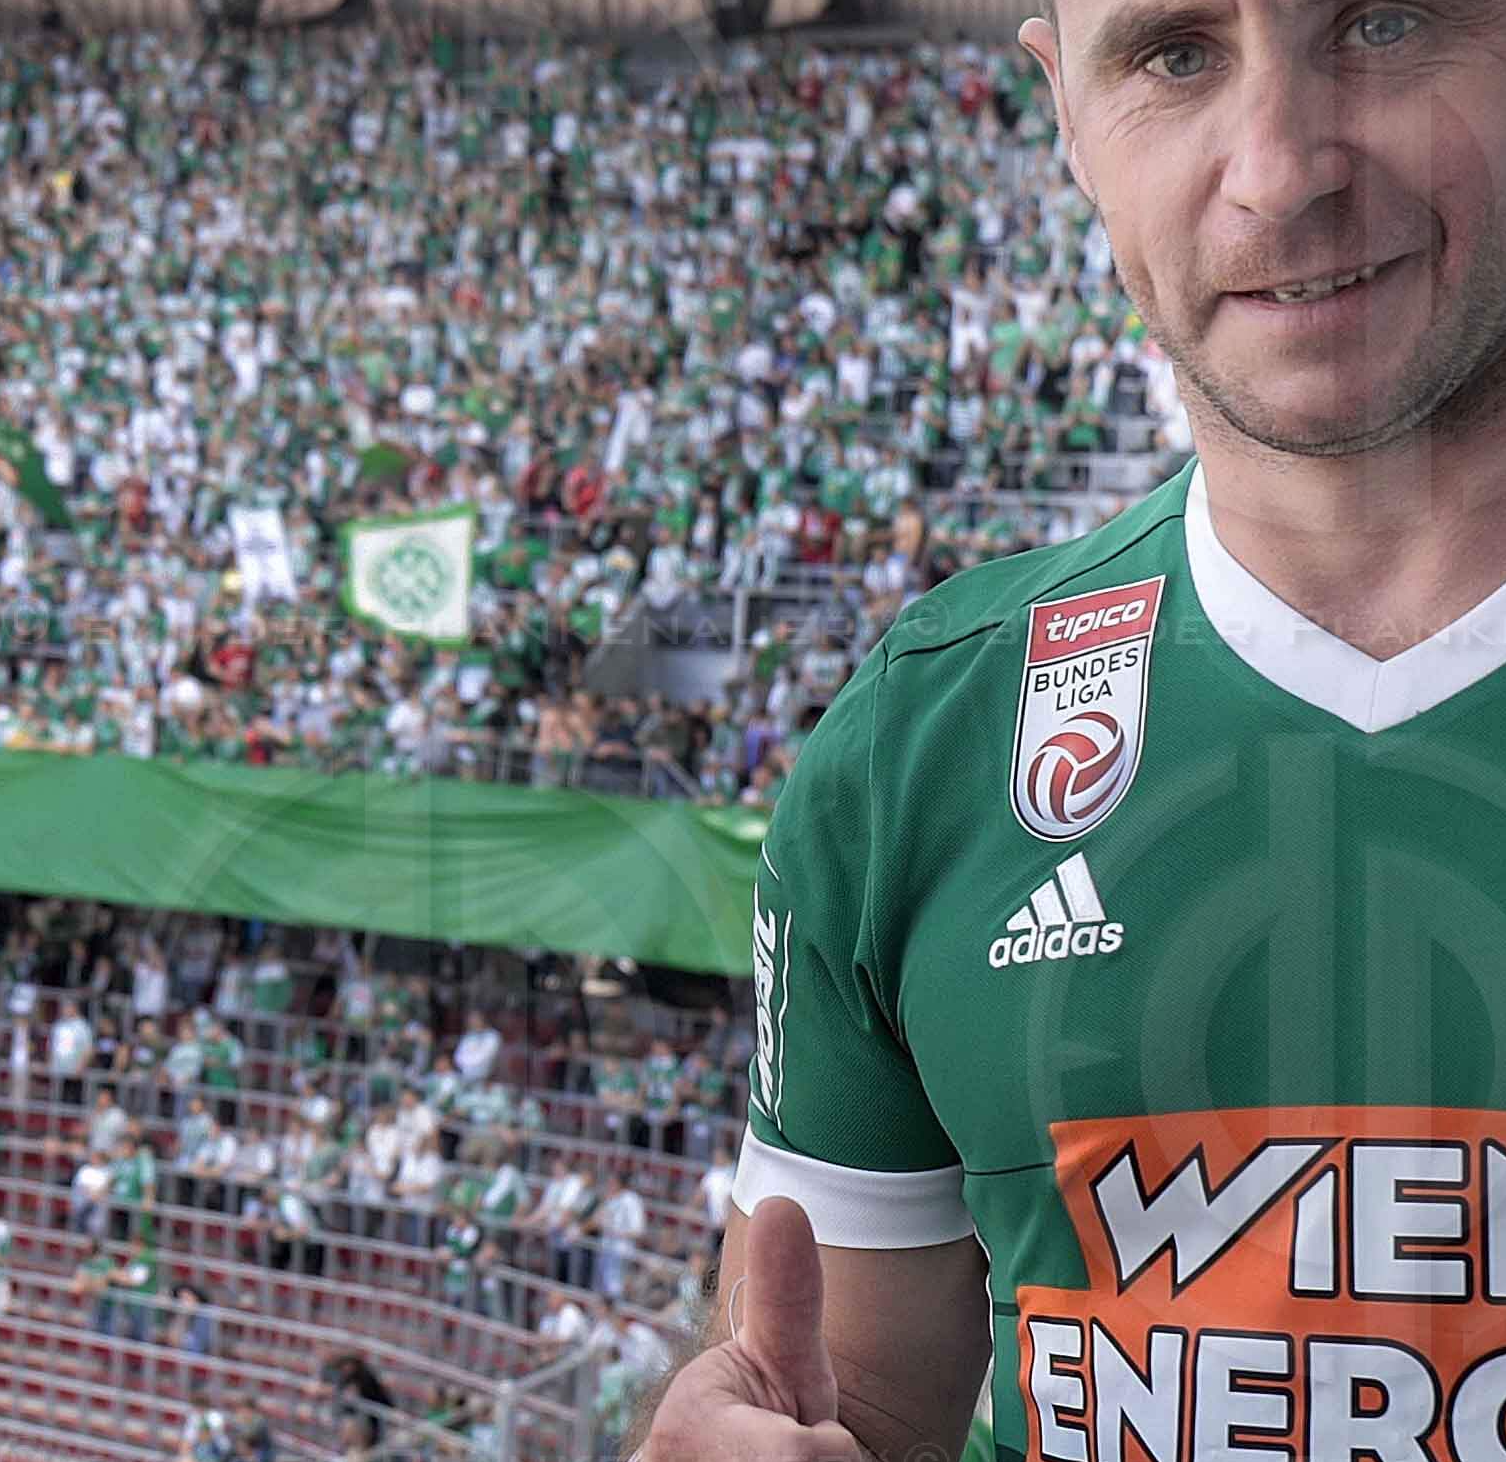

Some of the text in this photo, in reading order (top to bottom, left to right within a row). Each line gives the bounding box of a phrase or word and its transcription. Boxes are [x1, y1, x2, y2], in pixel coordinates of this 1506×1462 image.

[1046, 599, 1146, 642] tipico
[1034, 647, 1139, 693] BUNDES
[1055, 679, 1112, 711] LIGA
[989, 922, 1124, 968] adidas
